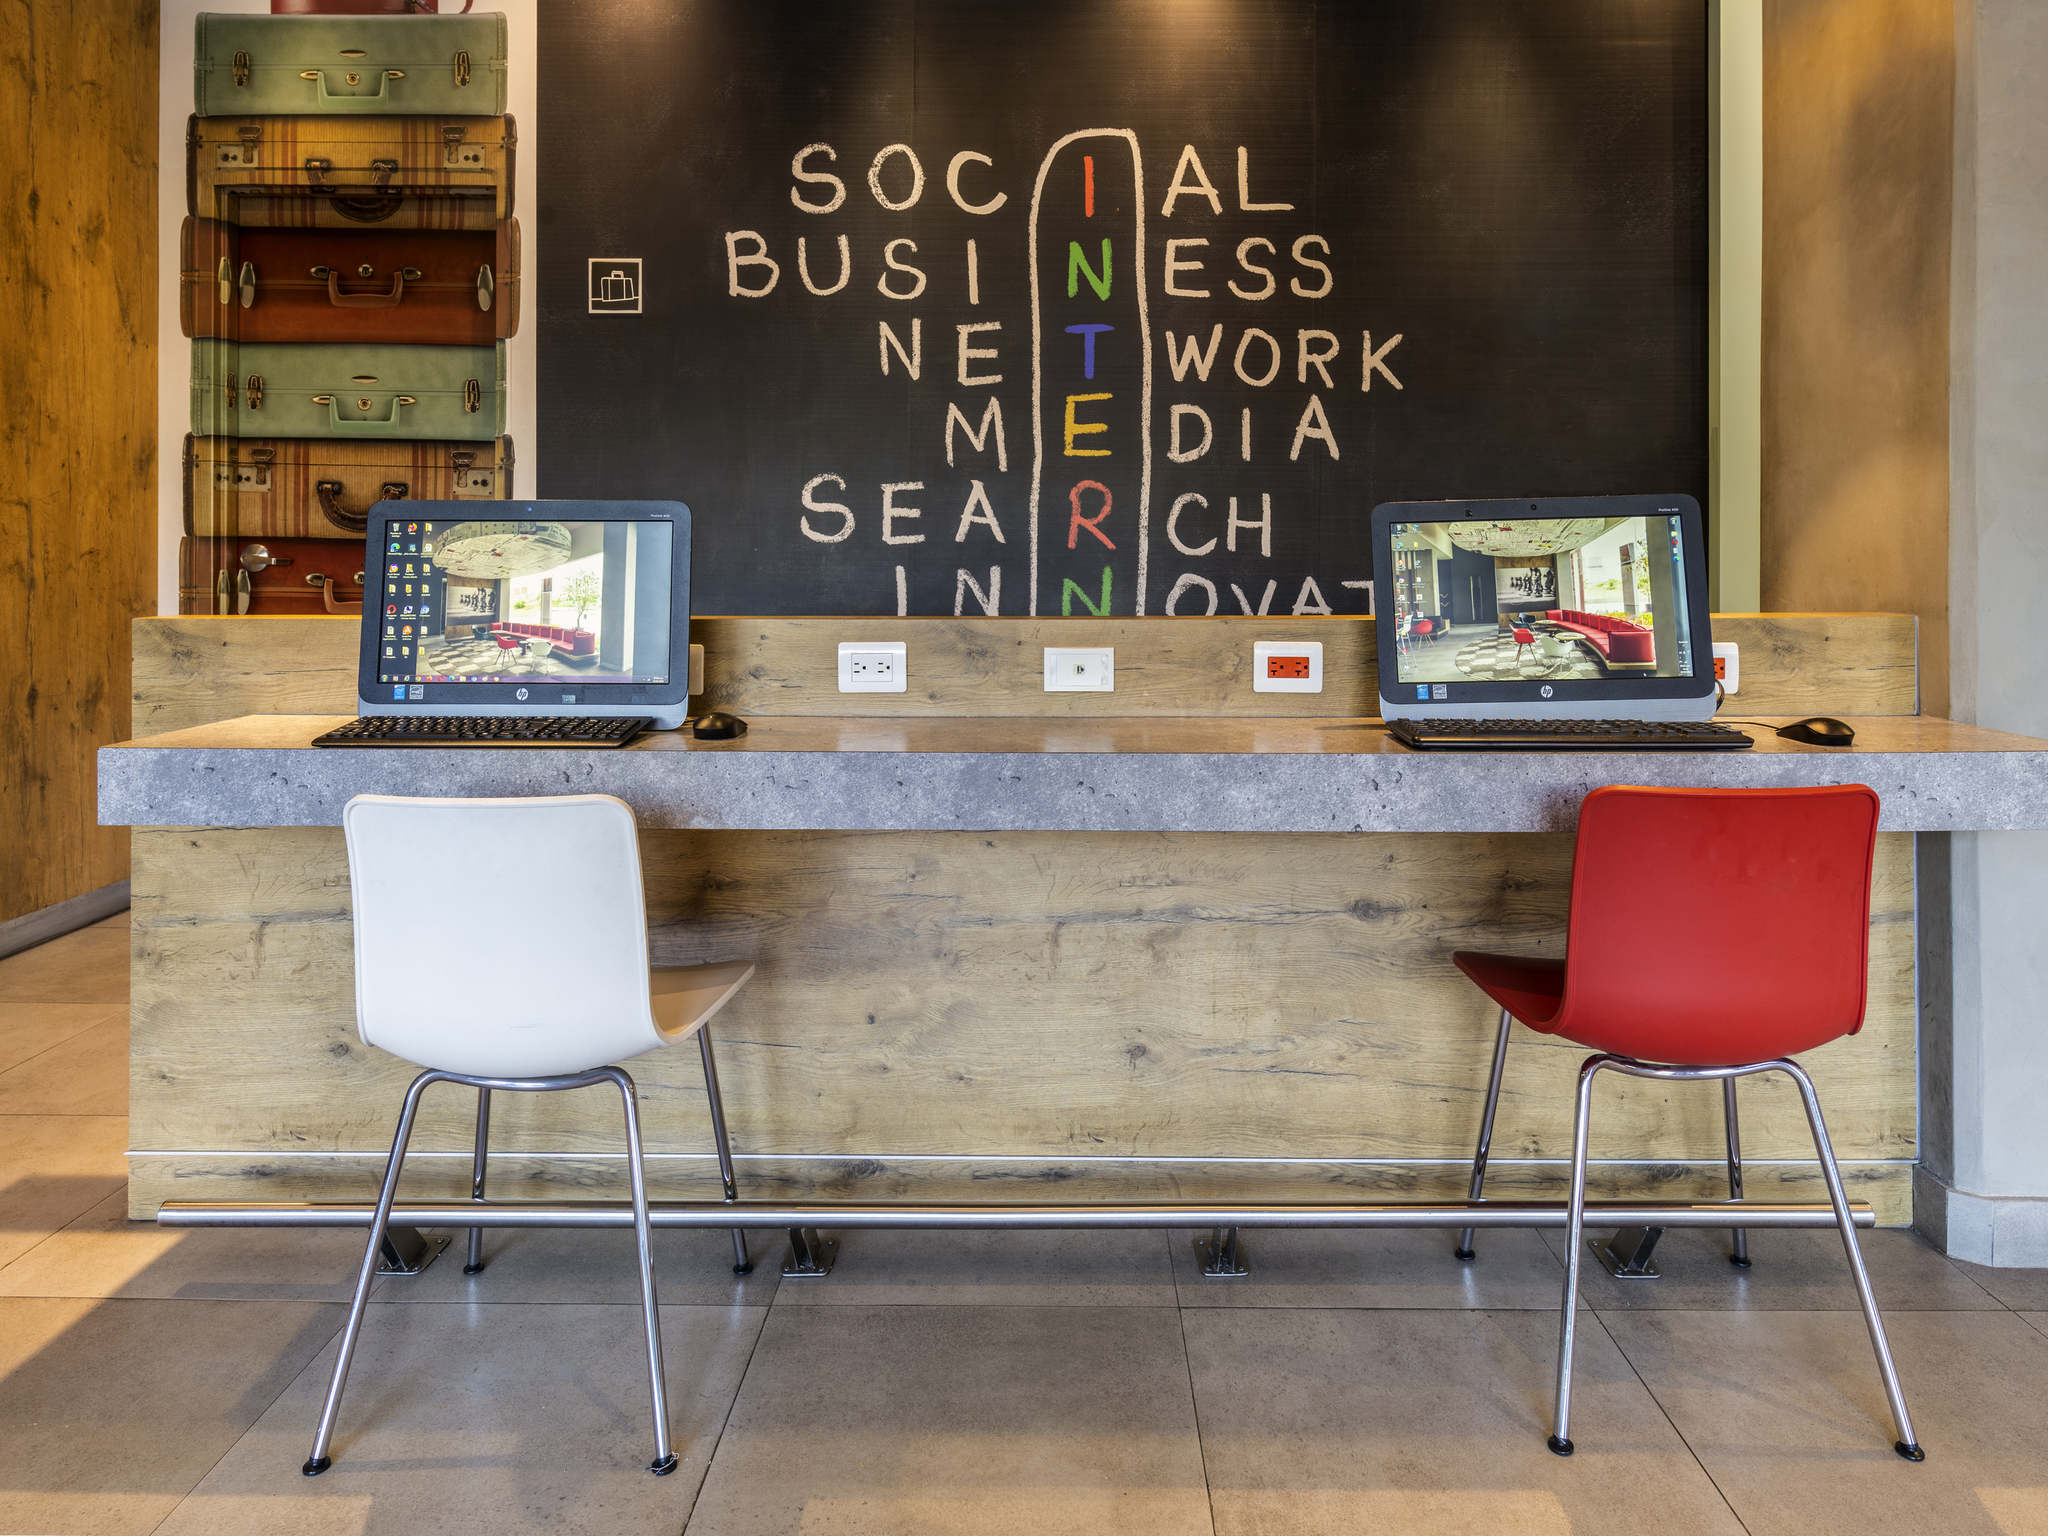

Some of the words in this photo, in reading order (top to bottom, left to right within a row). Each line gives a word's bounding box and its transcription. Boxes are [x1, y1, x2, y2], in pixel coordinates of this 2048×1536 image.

[791, 143, 1296, 218] SOCIAL
[725, 230, 1334, 306] BUSINESS
[879, 318, 1404, 393] NETWORK
[945, 393, 1340, 472] MEDIA
[800, 473, 1272, 557] SEARCH
